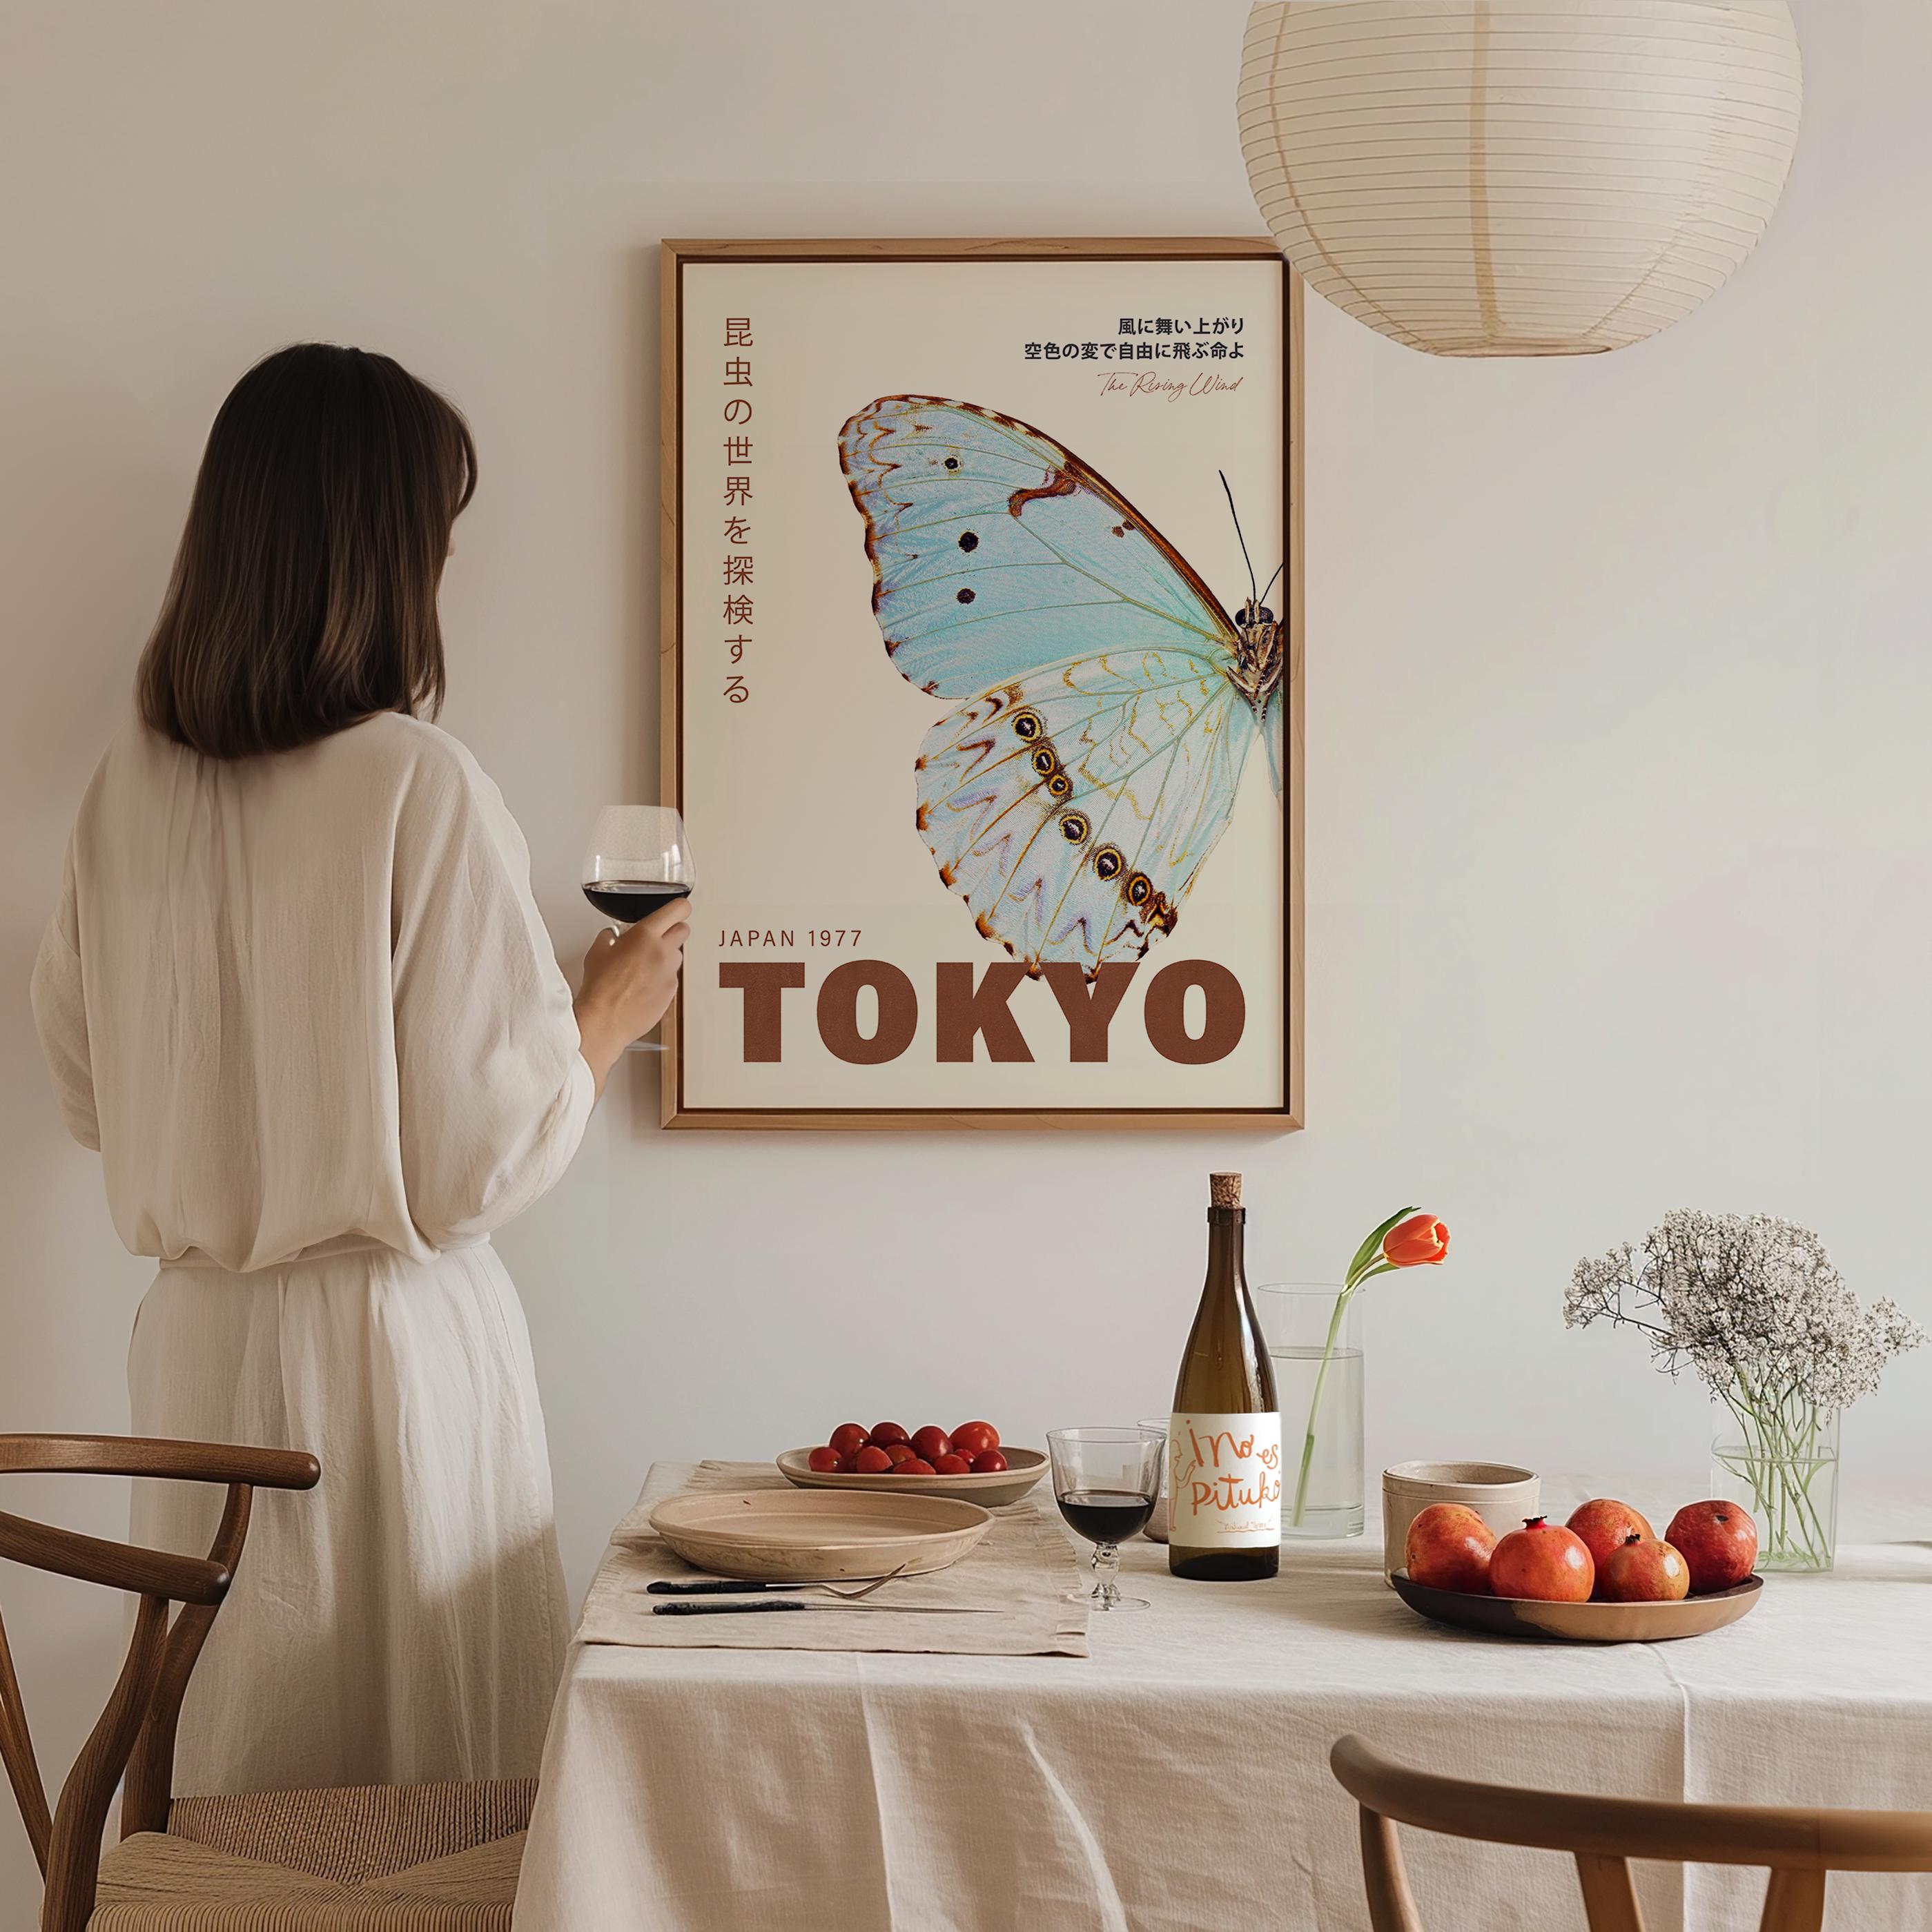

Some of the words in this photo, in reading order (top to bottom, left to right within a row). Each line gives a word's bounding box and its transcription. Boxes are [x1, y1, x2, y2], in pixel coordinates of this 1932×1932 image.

[1118, 317, 1244, 335] 風に舞い上がり
[1024, 342, 1245, 360] 空色の変で自由に飛ぶ命よ
[1097, 371, 1138, 396] The
[1130, 371, 1187, 402] Rising
[1189, 373, 1243, 396] Wind
[723, 318, 754, 704] 昆虫の世界を探検する
[719, 930, 794, 947] JAPAN
[808, 930, 861, 947] 1977
[719, 959, 1245, 1065] TOKYO
